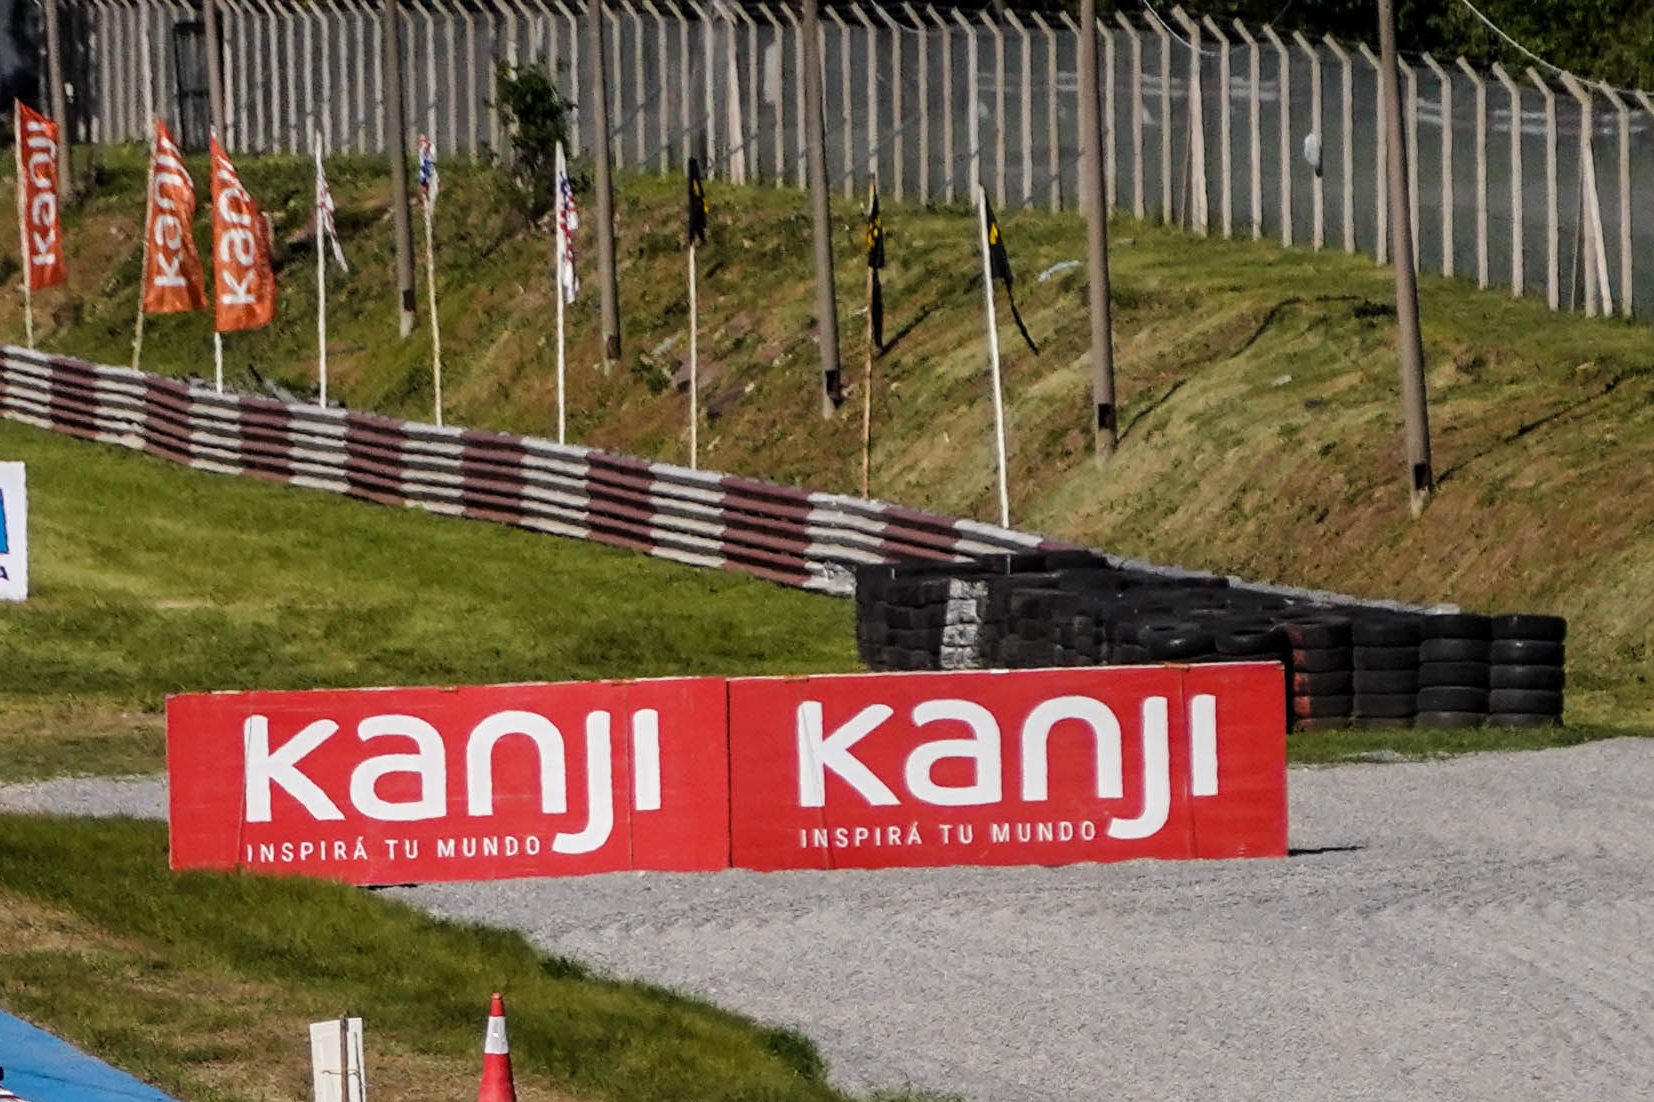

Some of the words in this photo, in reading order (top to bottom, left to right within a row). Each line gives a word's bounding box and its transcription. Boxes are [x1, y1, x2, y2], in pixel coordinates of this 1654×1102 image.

[244, 708, 662, 855] kanji
[797, 694, 1219, 840] kanji
[246, 835, 368, 862] INSPIRÁ
[384, 837, 419, 859] TU
[437, 835, 542, 858] MUNDO
[800, 821, 923, 848] INSPIRÁ
[941, 824, 975, 845] TU
[991, 820, 1097, 843] MUNDO
